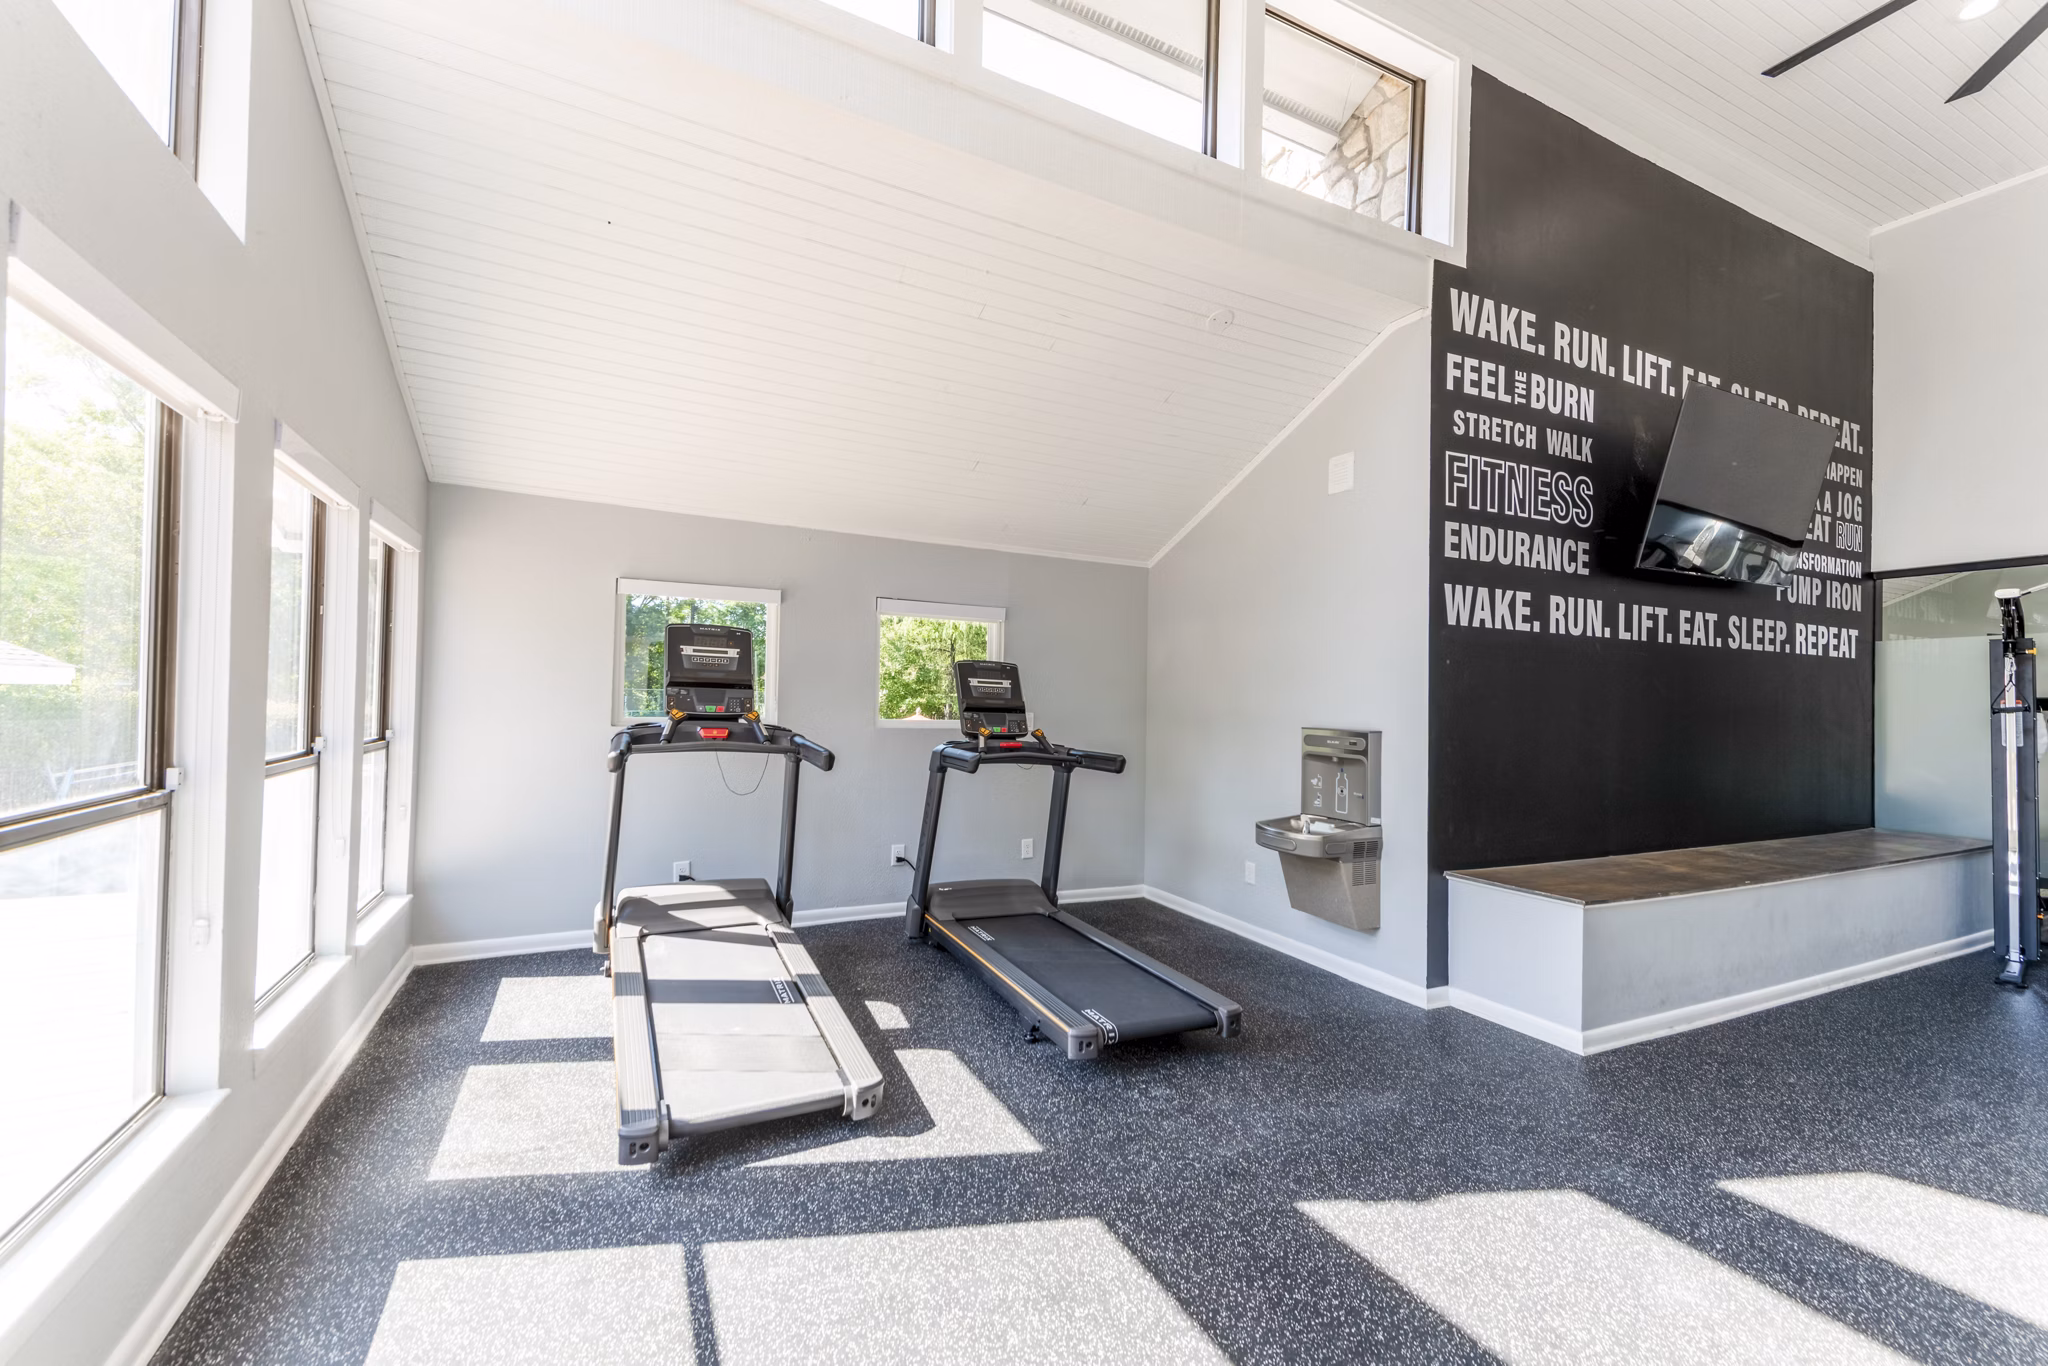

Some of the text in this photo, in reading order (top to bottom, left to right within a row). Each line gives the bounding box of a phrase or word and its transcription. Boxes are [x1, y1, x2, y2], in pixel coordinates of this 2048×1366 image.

[1450, 287, 1545, 356] WAKE.
[1554, 321, 1615, 377] RUN.
[1623, 344, 1675, 397] LIFT.
[1447, 352, 1594, 423] FEEL THE BURN
[1453, 410, 1593, 463] STRETCH WALK
[1446, 451, 1594, 528] FITNESS
[1823, 490, 1832, 514] A
[1836, 490, 1862, 522] JOG
[1445, 521, 1590, 576] ENDURANCE
[1836, 520, 1863, 552] RUN
[1444, 583, 1541, 632] WAKE.
[1550, 595, 1611, 638] RUN.
[1618, 603, 1673, 644] LIFT.
[1679, 609, 1722, 647] EAT.
[1728, 615, 1791, 653] SLEEP.
[1795, 623, 1859, 659] REPEAT
[1826, 580, 1862, 612] IRON
